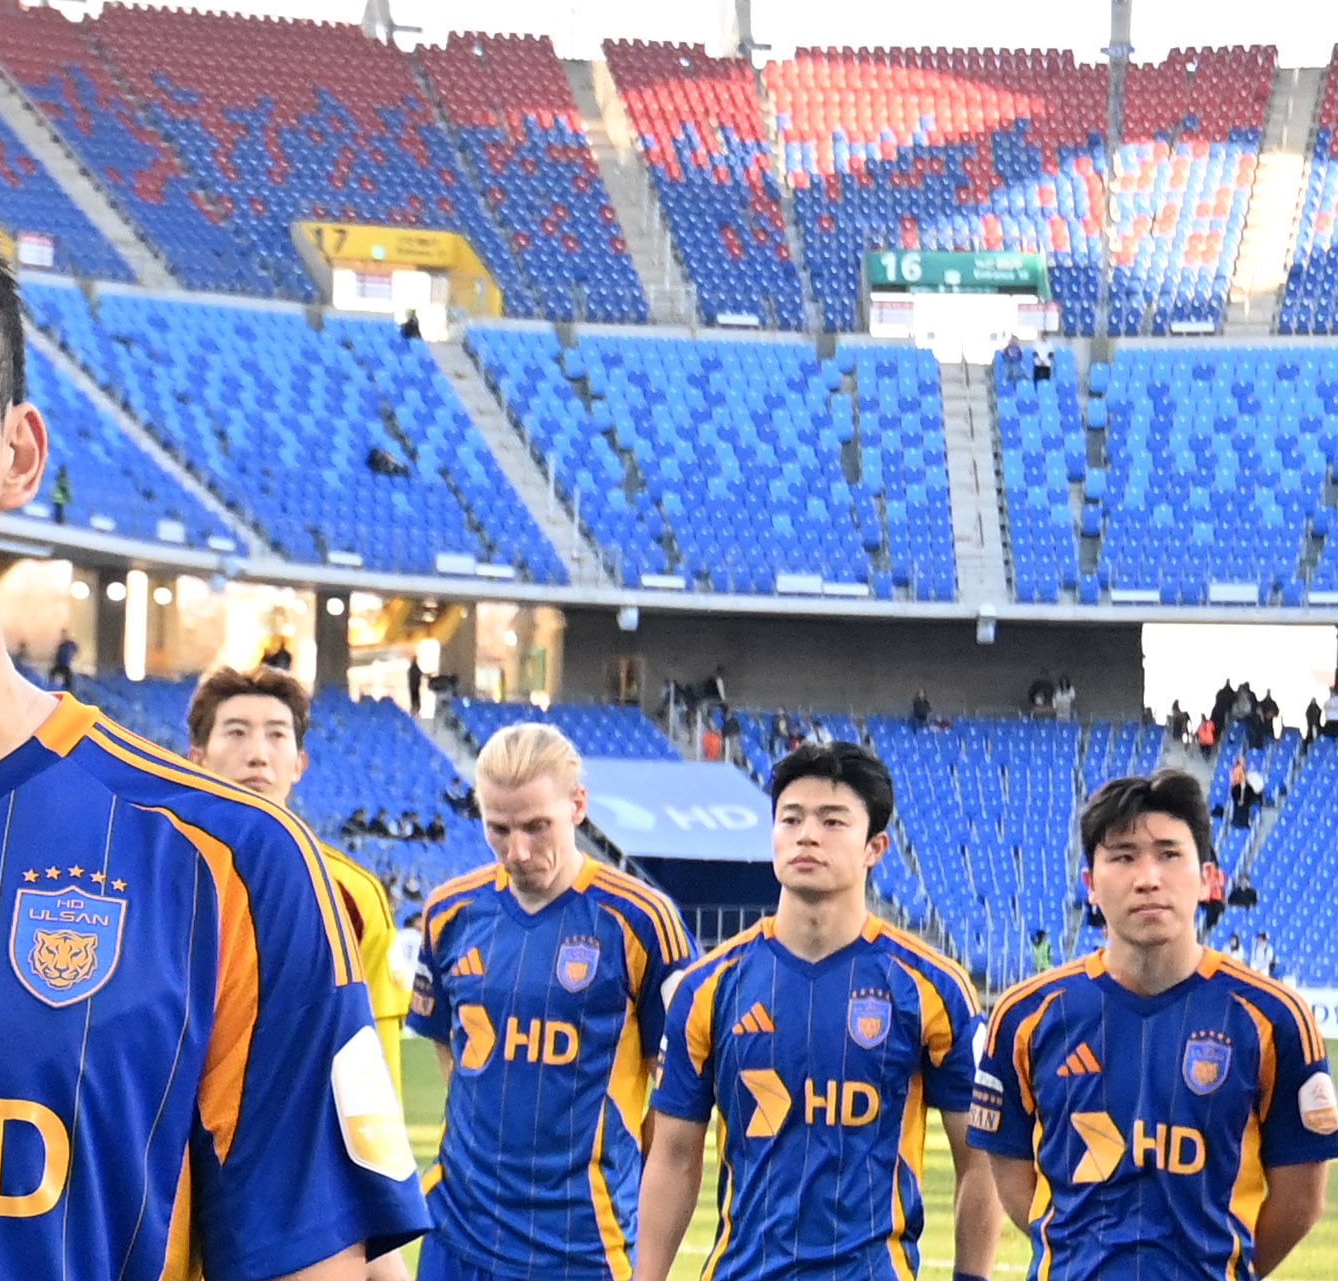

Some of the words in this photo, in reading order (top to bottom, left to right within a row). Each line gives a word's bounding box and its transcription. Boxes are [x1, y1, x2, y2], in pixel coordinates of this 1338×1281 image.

[315, 228, 347, 253] 17
[880, 252, 922, 282] 16
[663, 805, 758, 831] HD
[29, 908, 109, 926] ULSAN
[57, 899, 84, 909] HD
[504, 1016, 580, 1066] HD
[805, 1078, 880, 1127] HD
[1133, 1119, 1207, 1175] HD
